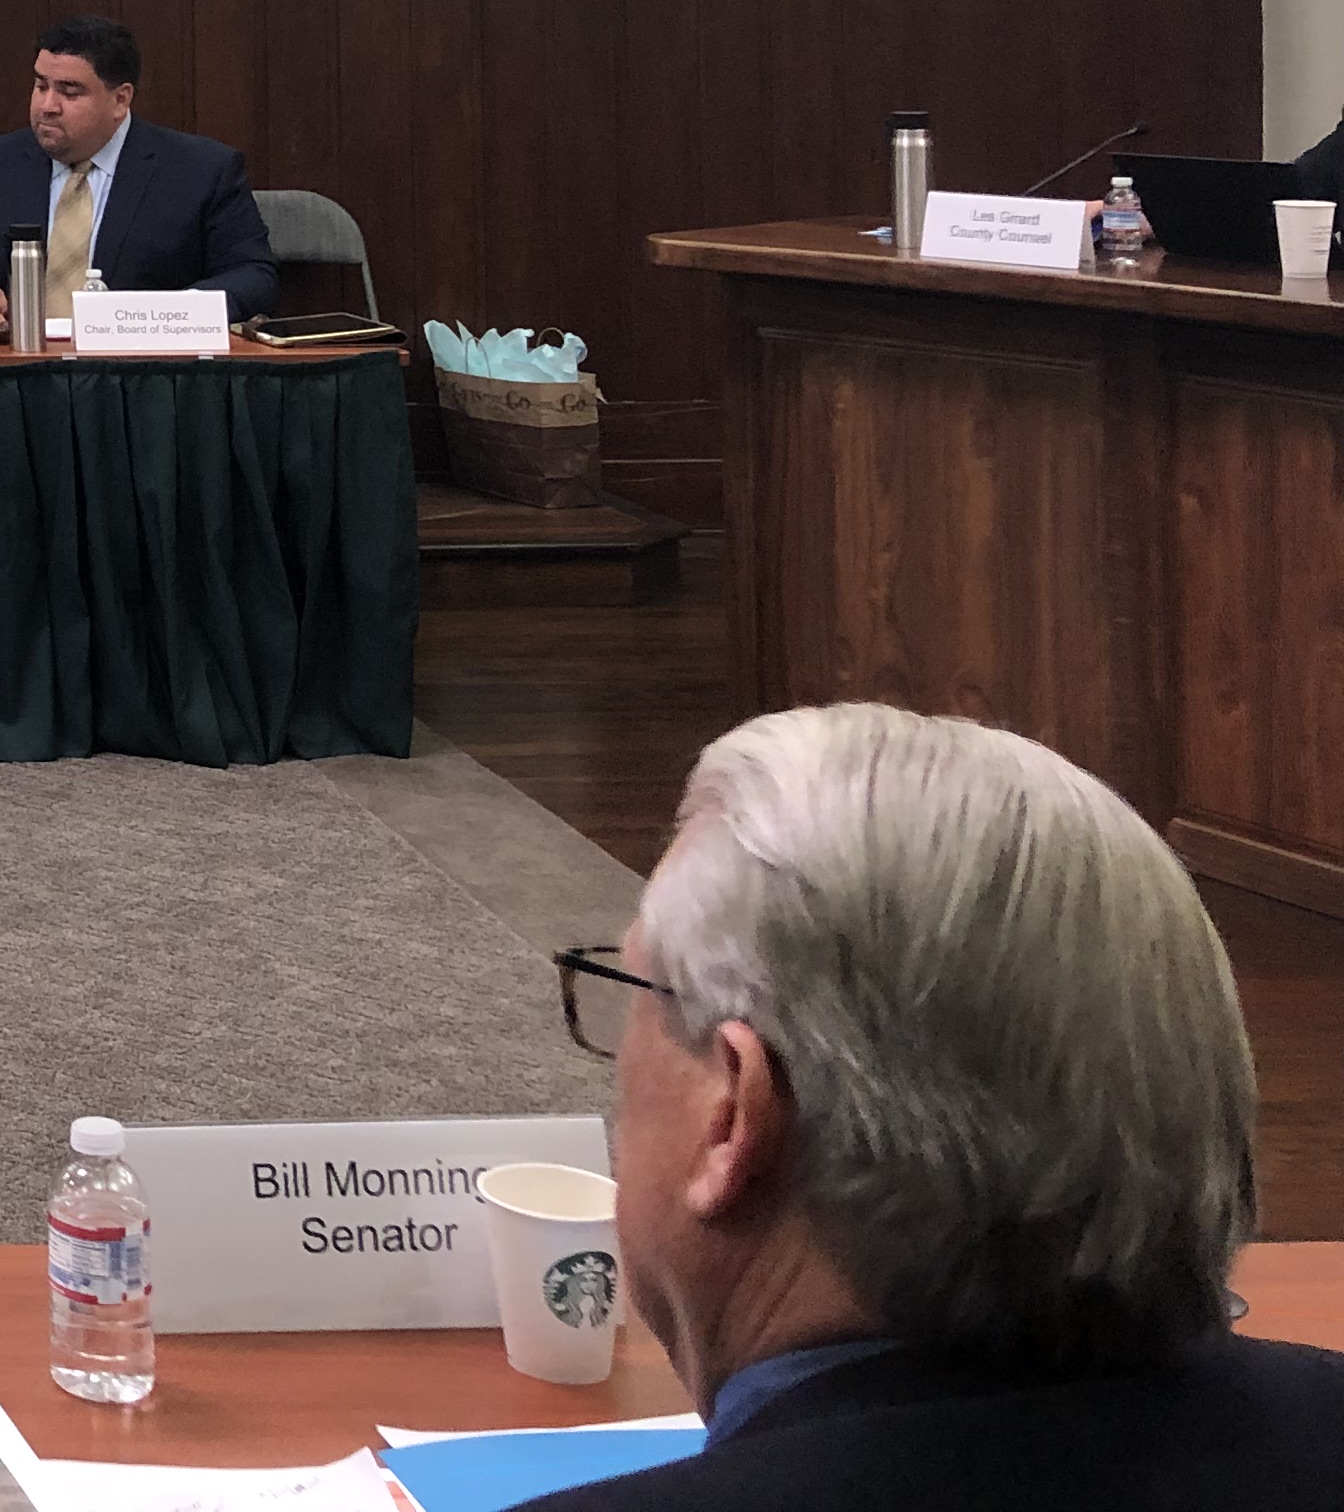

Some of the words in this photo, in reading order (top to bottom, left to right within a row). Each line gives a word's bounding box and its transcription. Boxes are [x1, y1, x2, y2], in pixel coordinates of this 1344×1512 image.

[950, 225, 994, 243] County
[998, 228, 1053, 245] Counsel
[114, 309, 147, 321] Chris
[150, 309, 189, 322] Lopez
[84, 324, 114, 335] Chair,
[117, 324, 147, 334] Board
[150, 324, 160, 334] of
[162, 324, 222, 336] Supervisors
[252, 1161, 311, 1199] Bill
[301, 1216, 459, 1254] Senator
